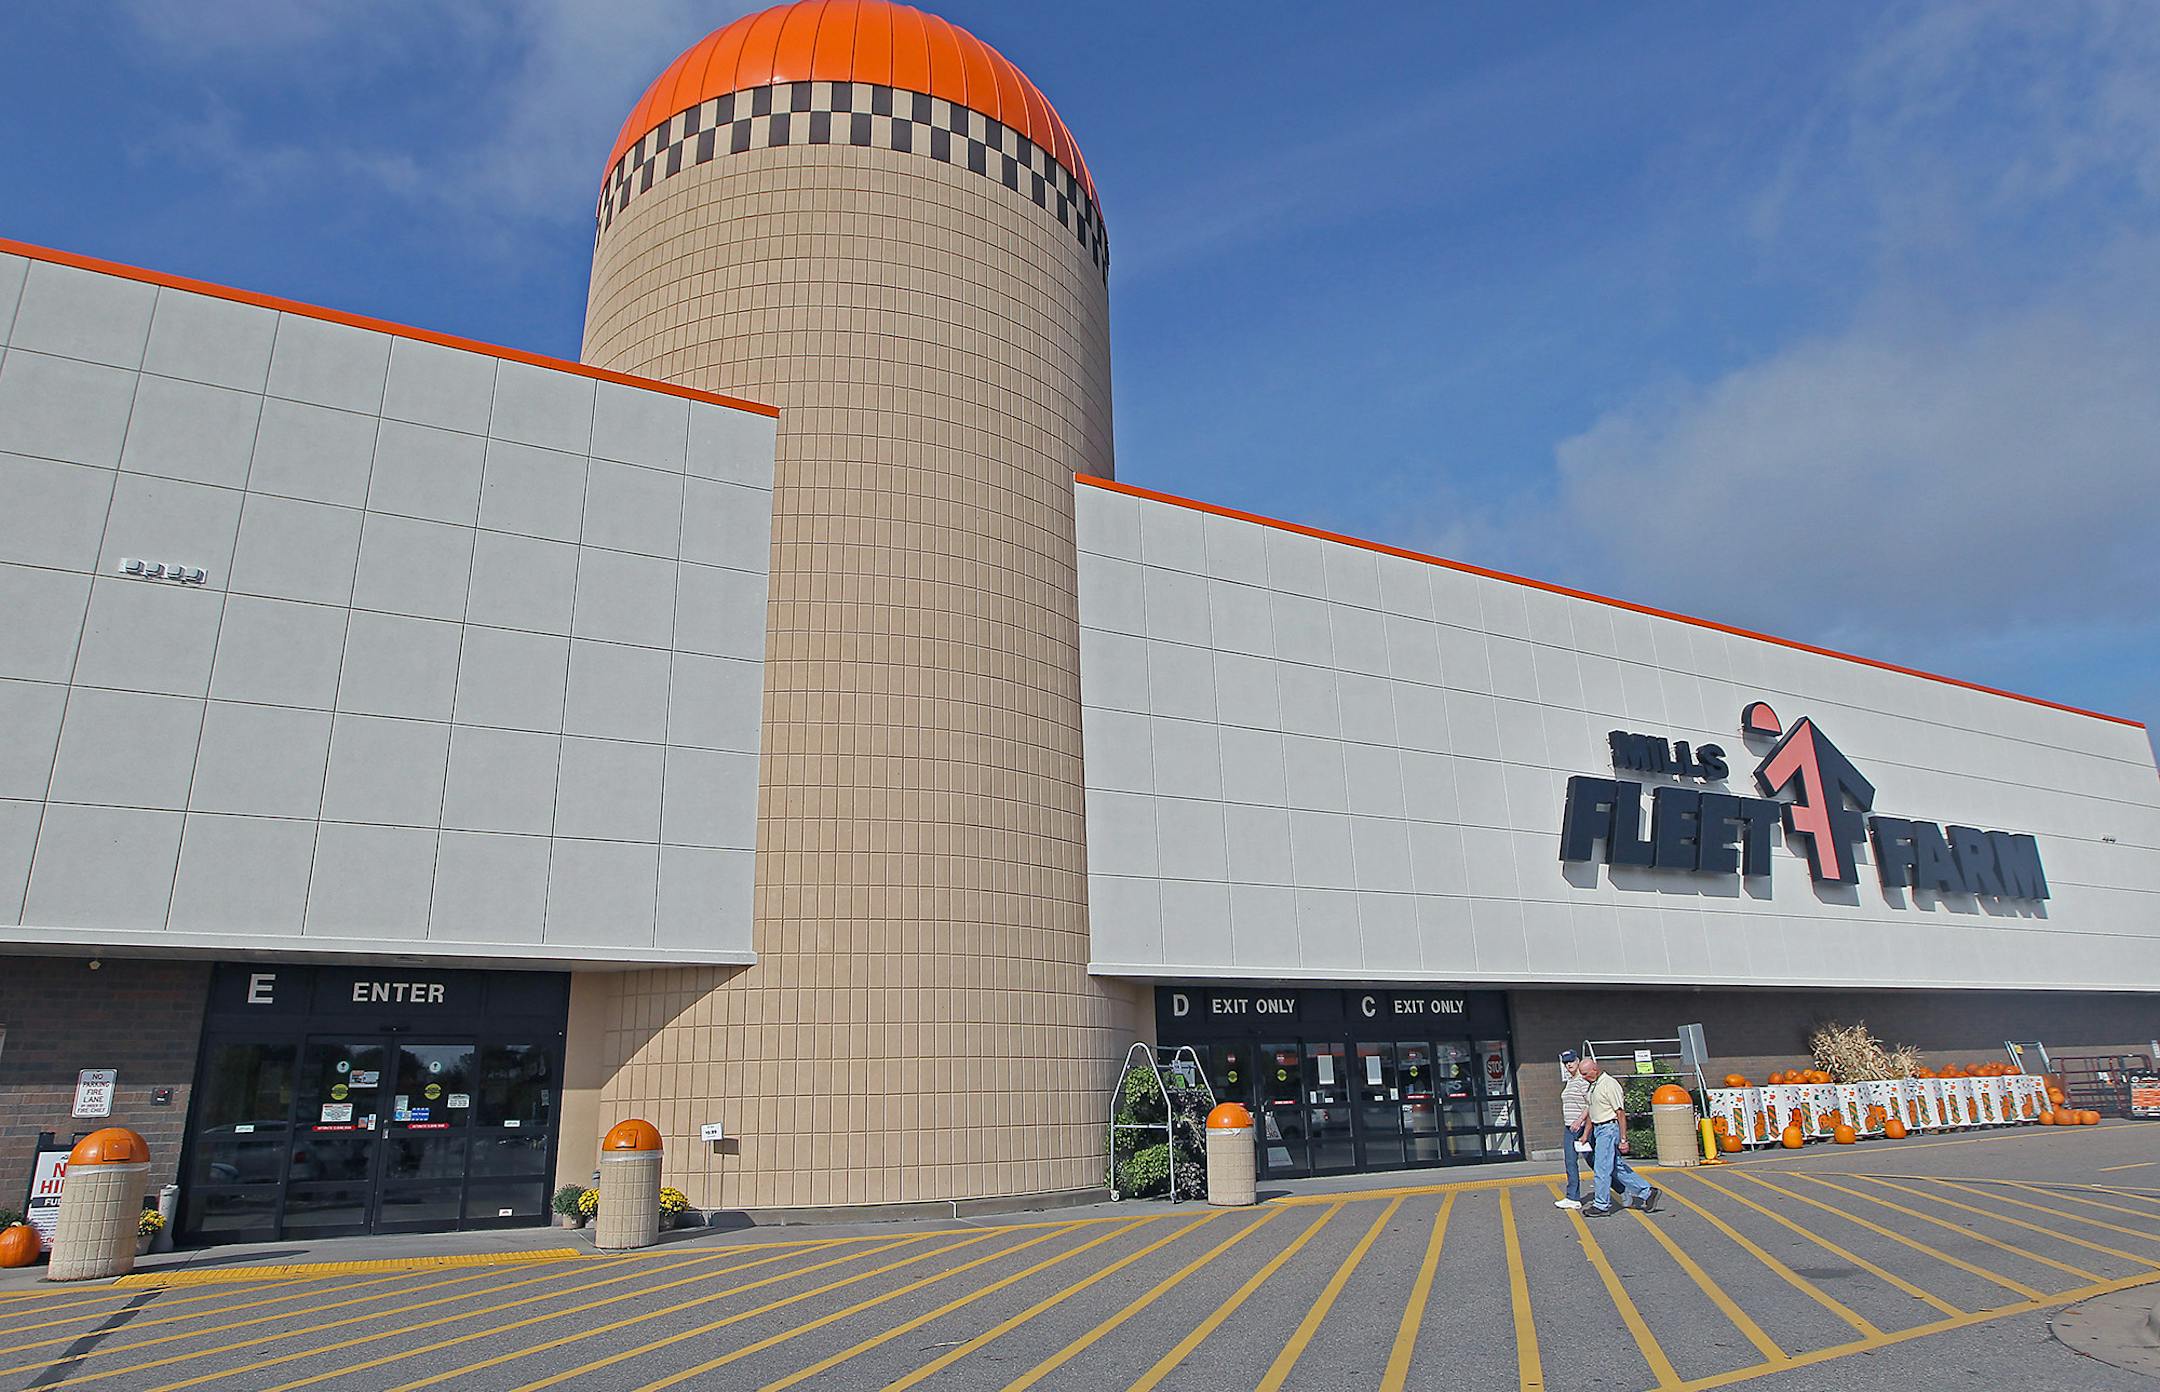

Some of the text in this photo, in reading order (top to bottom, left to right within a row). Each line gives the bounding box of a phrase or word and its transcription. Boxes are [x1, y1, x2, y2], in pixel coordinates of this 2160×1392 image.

[1608, 730, 1729, 783] MILLS
[1559, 776, 2051, 901] FLEET FARM
[248, 973, 276, 1004] E
[352, 982, 445, 1003] ENTER
[1173, 994, 1189, 1016] D
[1212, 999, 1295, 1014] EXIT ONLY
[1362, 996, 1376, 1017] C
[1394, 1000, 1464, 1014] EXIT ONLY
[1487, 1060, 1504, 1074] STOP
